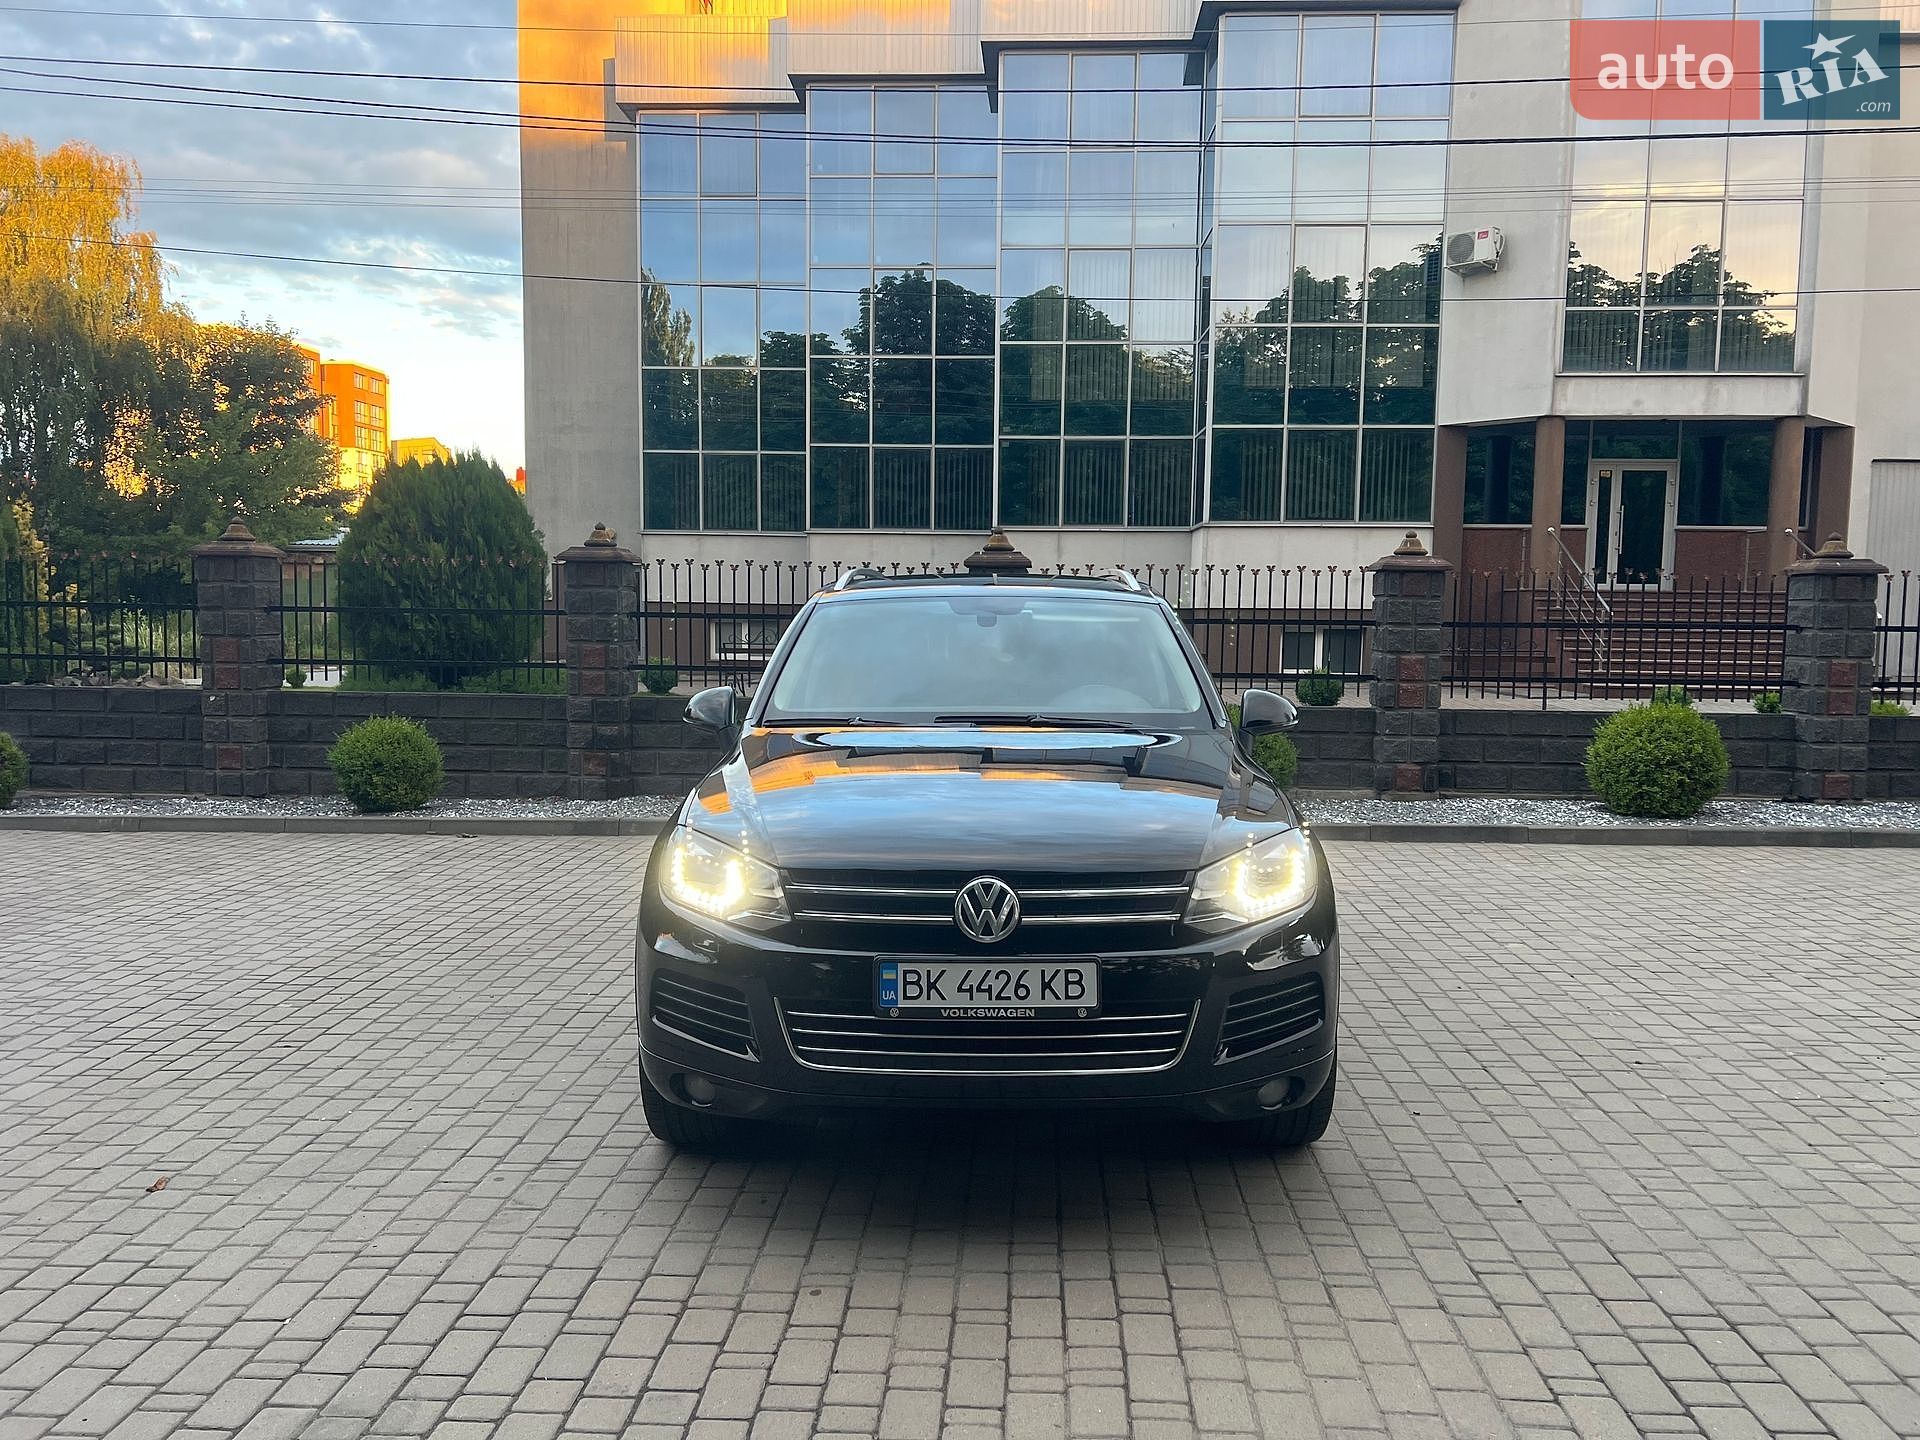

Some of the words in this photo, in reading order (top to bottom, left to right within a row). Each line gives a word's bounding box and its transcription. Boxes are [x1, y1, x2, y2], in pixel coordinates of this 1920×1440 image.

[902, 969, 948, 1001] BK
[956, 969, 1031, 1001] 4426
[1040, 968, 1086, 1001] KB
[882, 990, 896, 1000] UA
[940, 1008, 1035, 1017] VOLKSWAGEN
